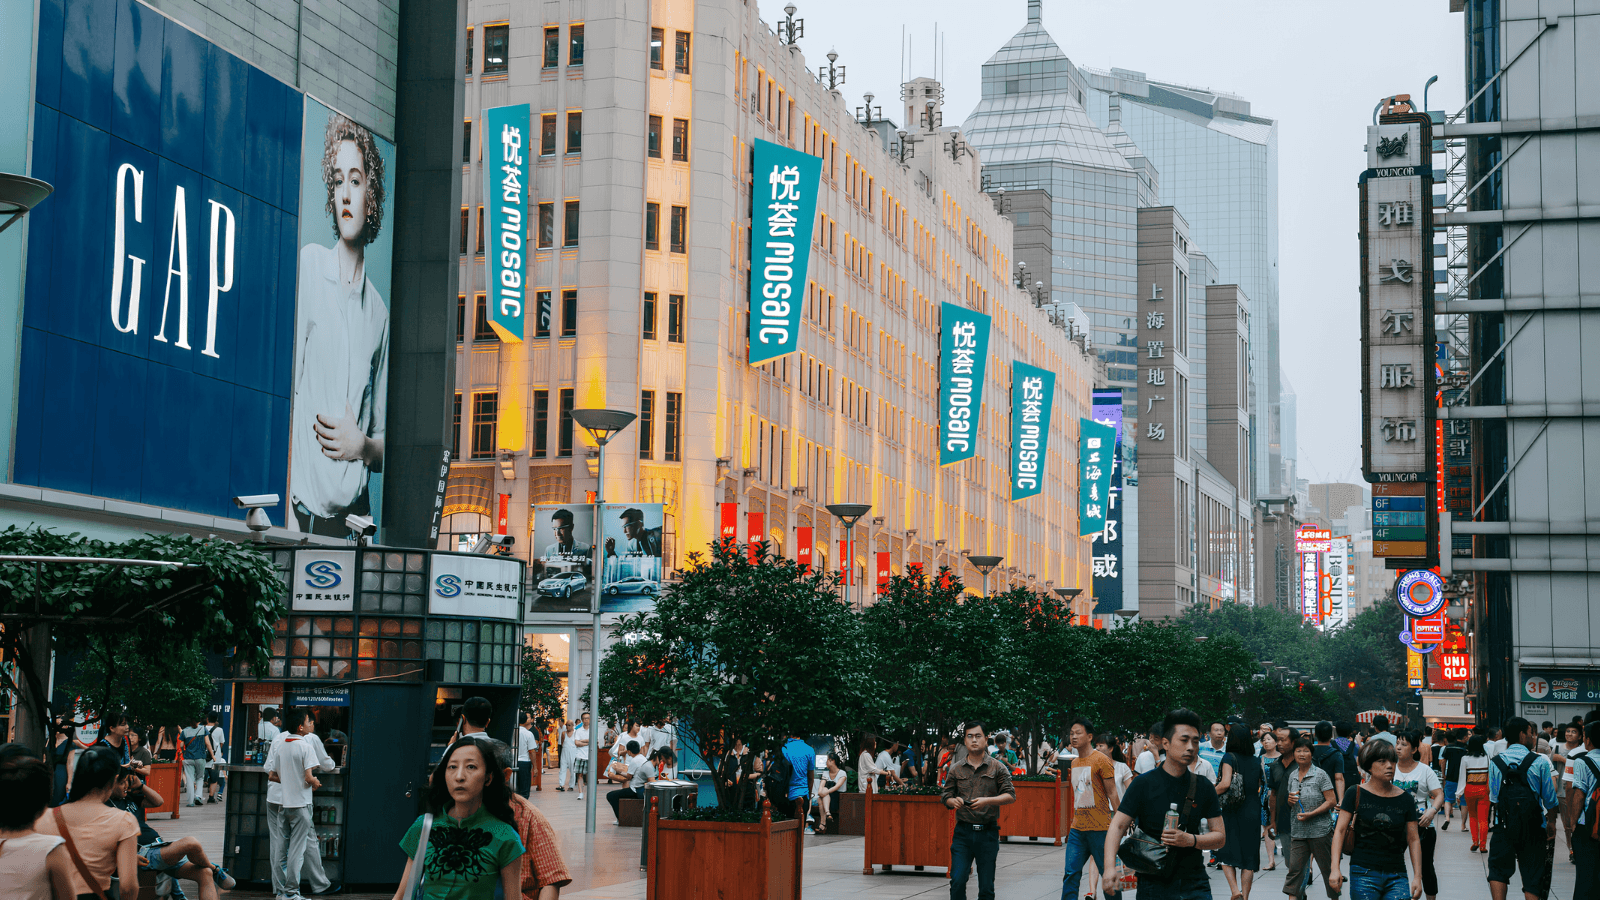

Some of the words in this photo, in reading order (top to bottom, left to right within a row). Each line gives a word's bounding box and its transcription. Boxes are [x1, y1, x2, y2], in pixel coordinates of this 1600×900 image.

[501, 124, 521, 205] 悦荟
[768, 164, 801, 238] 悦荟
[110, 163, 236, 359] GAP
[1378, 200, 1417, 443] 雅戈尔服饰
[951, 320, 976, 375] 悦荟
[1146, 282, 1166, 441] 上海置地广场
[1020, 375, 1043, 423] 悦荟
[1378, 472, 1418, 482] YOUNGOR
[1375, 485, 1388, 494] 7F
[1375, 499, 1389, 508] 6F
[1375, 514, 1389, 523] 5F
[1376, 529, 1389, 538] 4F
[1376, 543, 1389, 553] 3F
[1329, 555, 1342, 632] BOSIDEN
[1444, 656, 1465, 667] UNI
[1444, 667, 1467, 679] QLO
[1528, 682, 1547, 693] 3F
